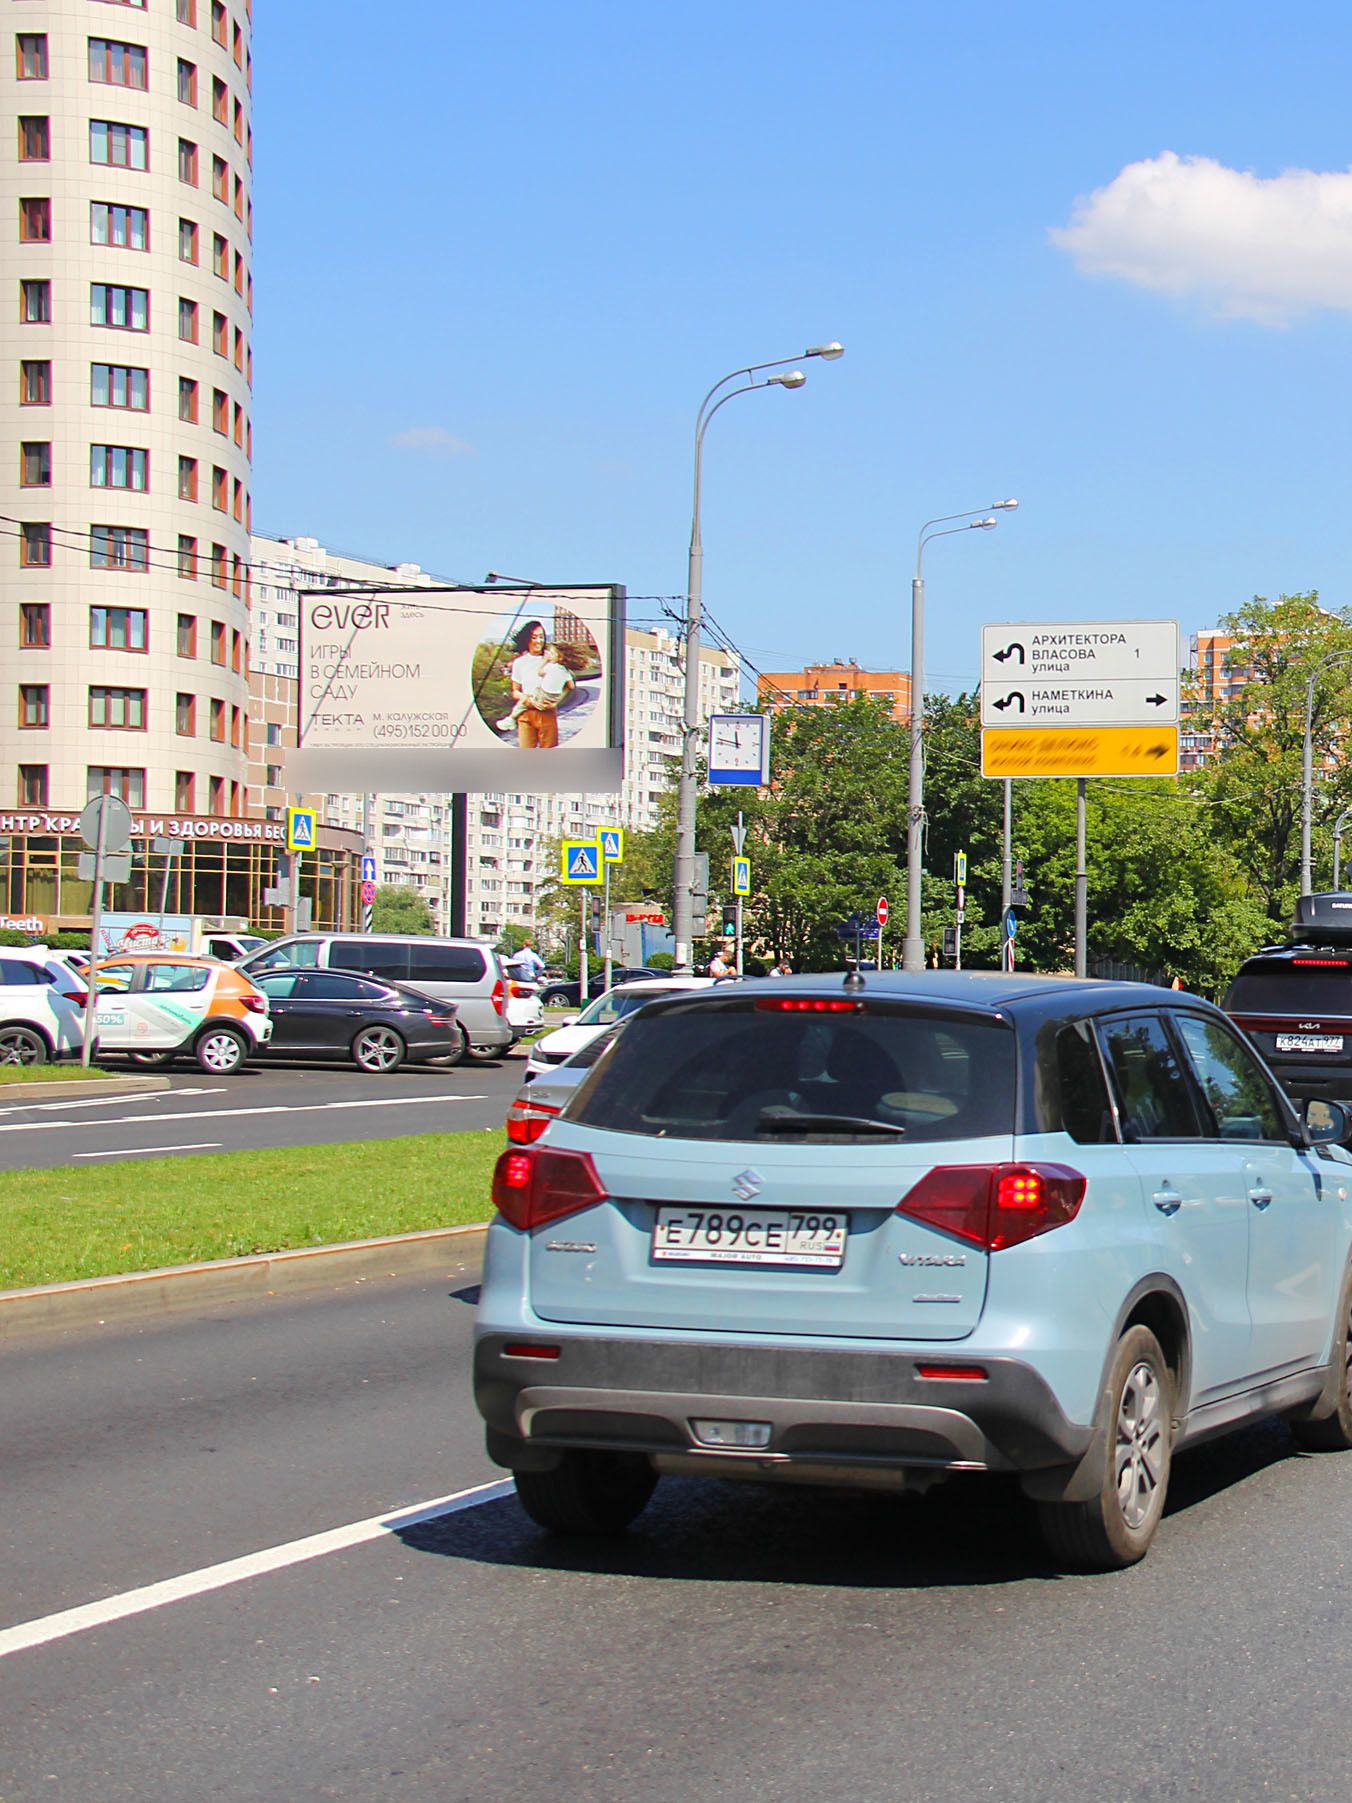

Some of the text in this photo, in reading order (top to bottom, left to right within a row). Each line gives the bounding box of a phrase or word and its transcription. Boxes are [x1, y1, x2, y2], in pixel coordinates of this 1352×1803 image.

[1031, 633, 1127, 645] АРХИТЕКТОРА
[310, 645, 351, 659] ИГРЫ
[1031, 649, 1096, 660] ВЛАСОВА
[310, 661, 421, 679] В СЕМЕЙНОМ
[1031, 662, 1070, 674] улица
[310, 685, 359, 701] САДУ
[1031, 689, 1114, 701] НАМЕТКИНА
[1031, 704, 1070, 716] улица
[310, 713, 365, 726] ТЕКТА
[1, 816, 41, 832] НТР
[46, 817, 145, 834] КРАЫ
[151, 820, 164, 834] И
[168, 821, 262, 839] ЗДОРОВЬЯ
[0, 916, 44, 931] Teeth
[800, 1242, 823, 1250] RUS
[710, 1252, 739, 1260] MAJOR
[898, 1253, 967, 1267] VITARA
